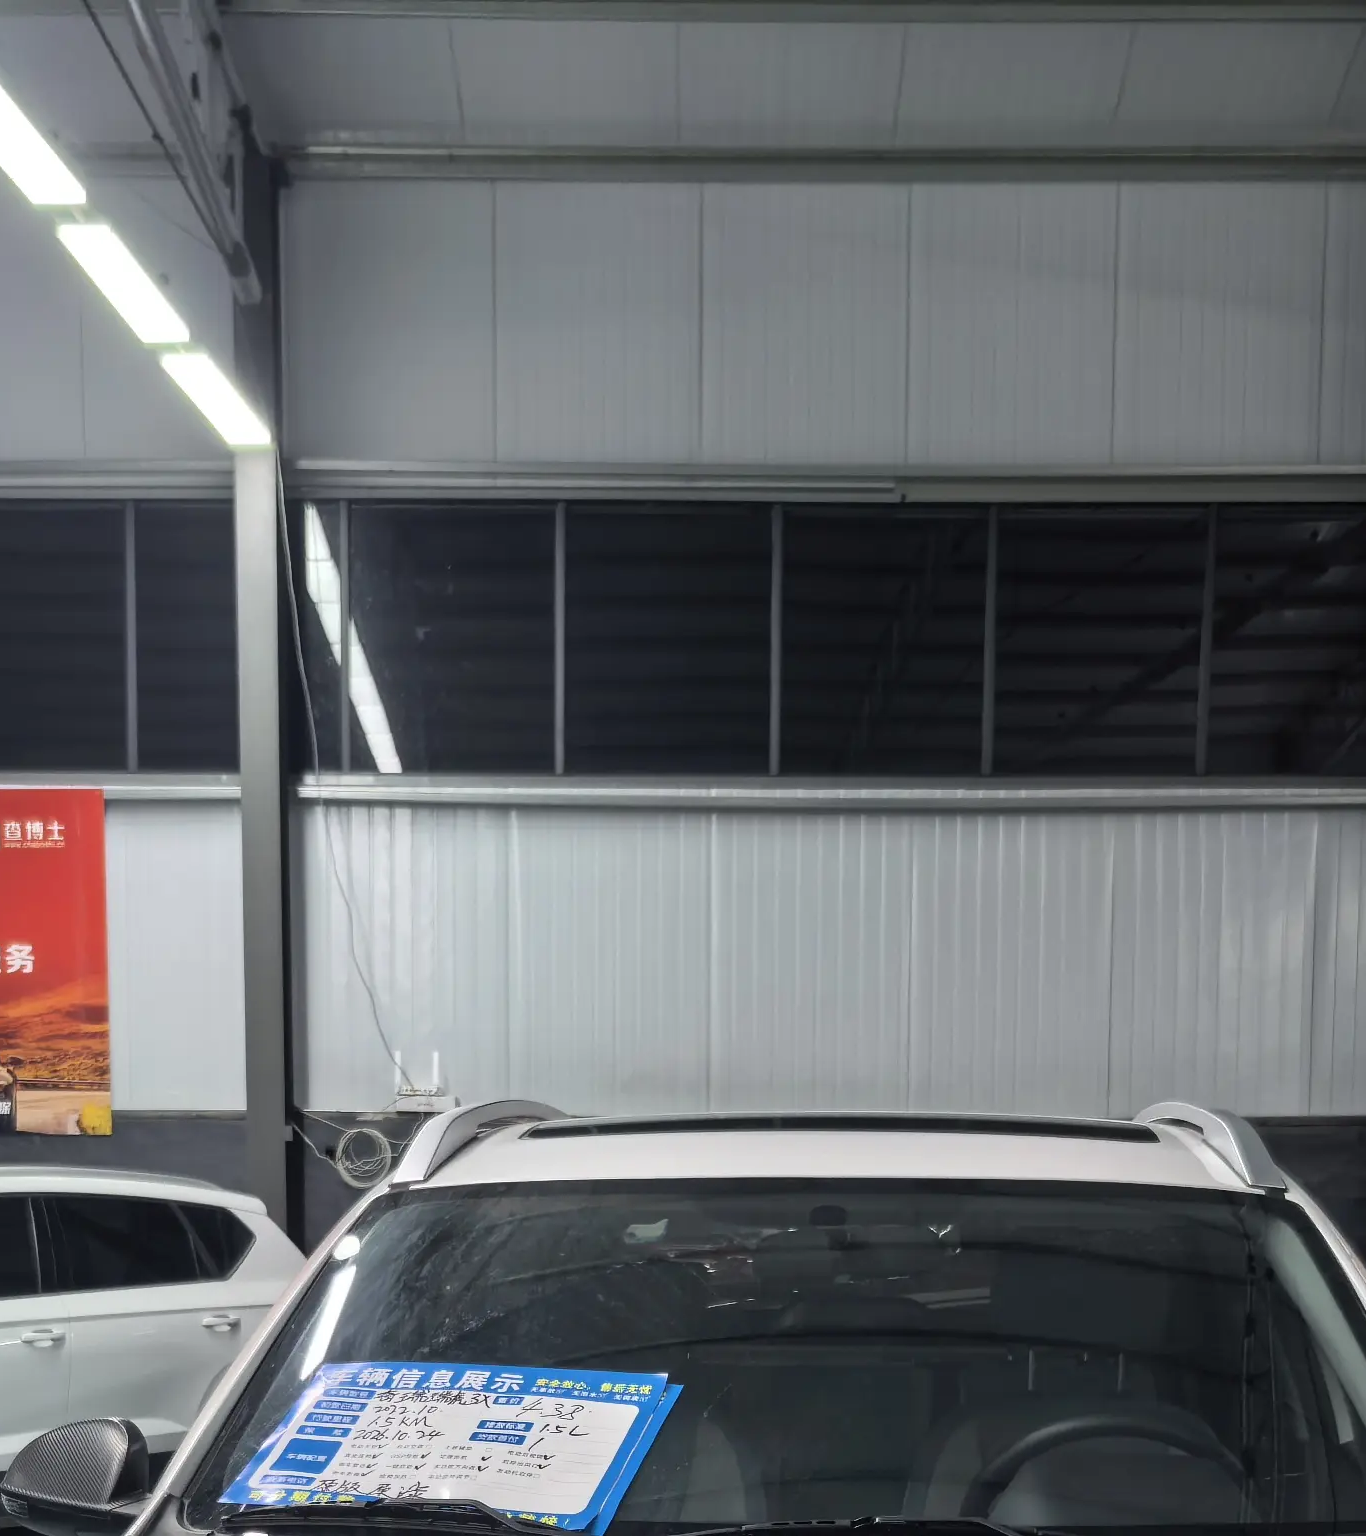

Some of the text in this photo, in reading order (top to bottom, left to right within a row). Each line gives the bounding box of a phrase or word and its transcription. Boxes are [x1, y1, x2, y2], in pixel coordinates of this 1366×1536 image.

[327, 1366, 524, 1392] 车辆信息展示
